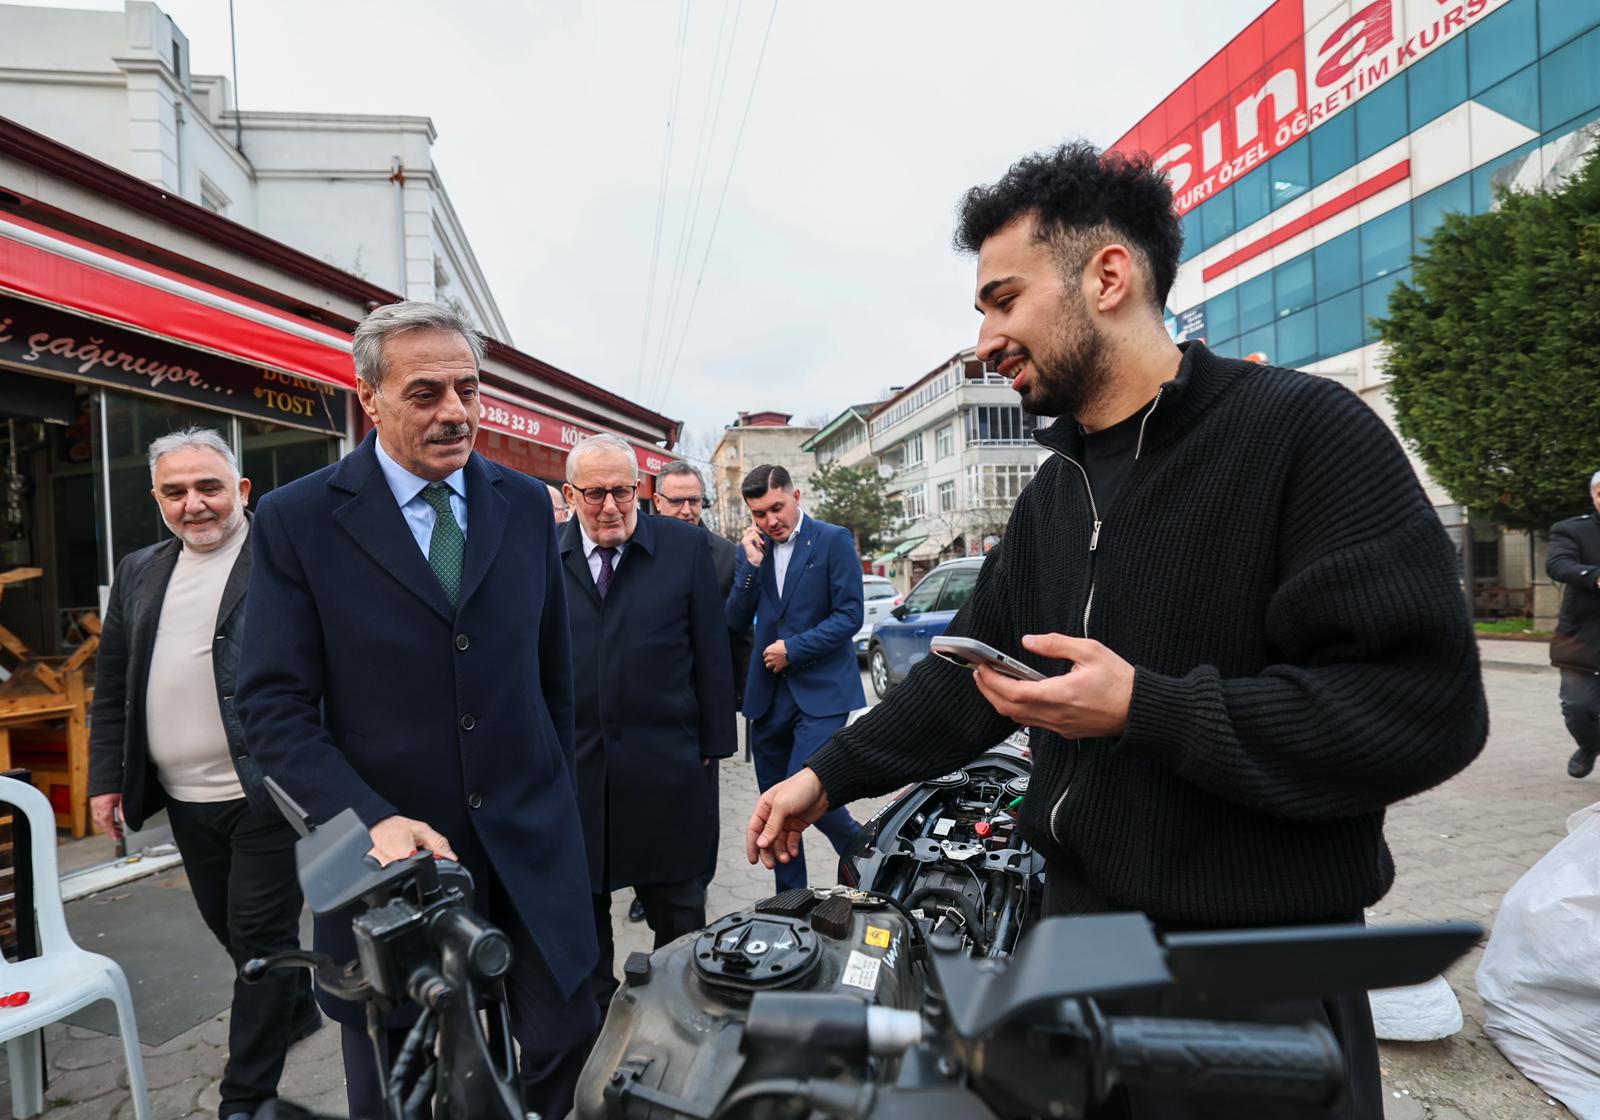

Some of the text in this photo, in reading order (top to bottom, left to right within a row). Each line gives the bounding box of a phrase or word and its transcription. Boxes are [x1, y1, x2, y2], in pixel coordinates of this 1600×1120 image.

[1218, 141, 1269, 184] ÖZEL
[1275, 55, 1389, 147] ÖĞRETİM
[263, 388, 316, 417] TOST
[487, 406, 509, 426] 282
[511, 414, 525, 430] 32
[526, 419, 540, 435] 39
